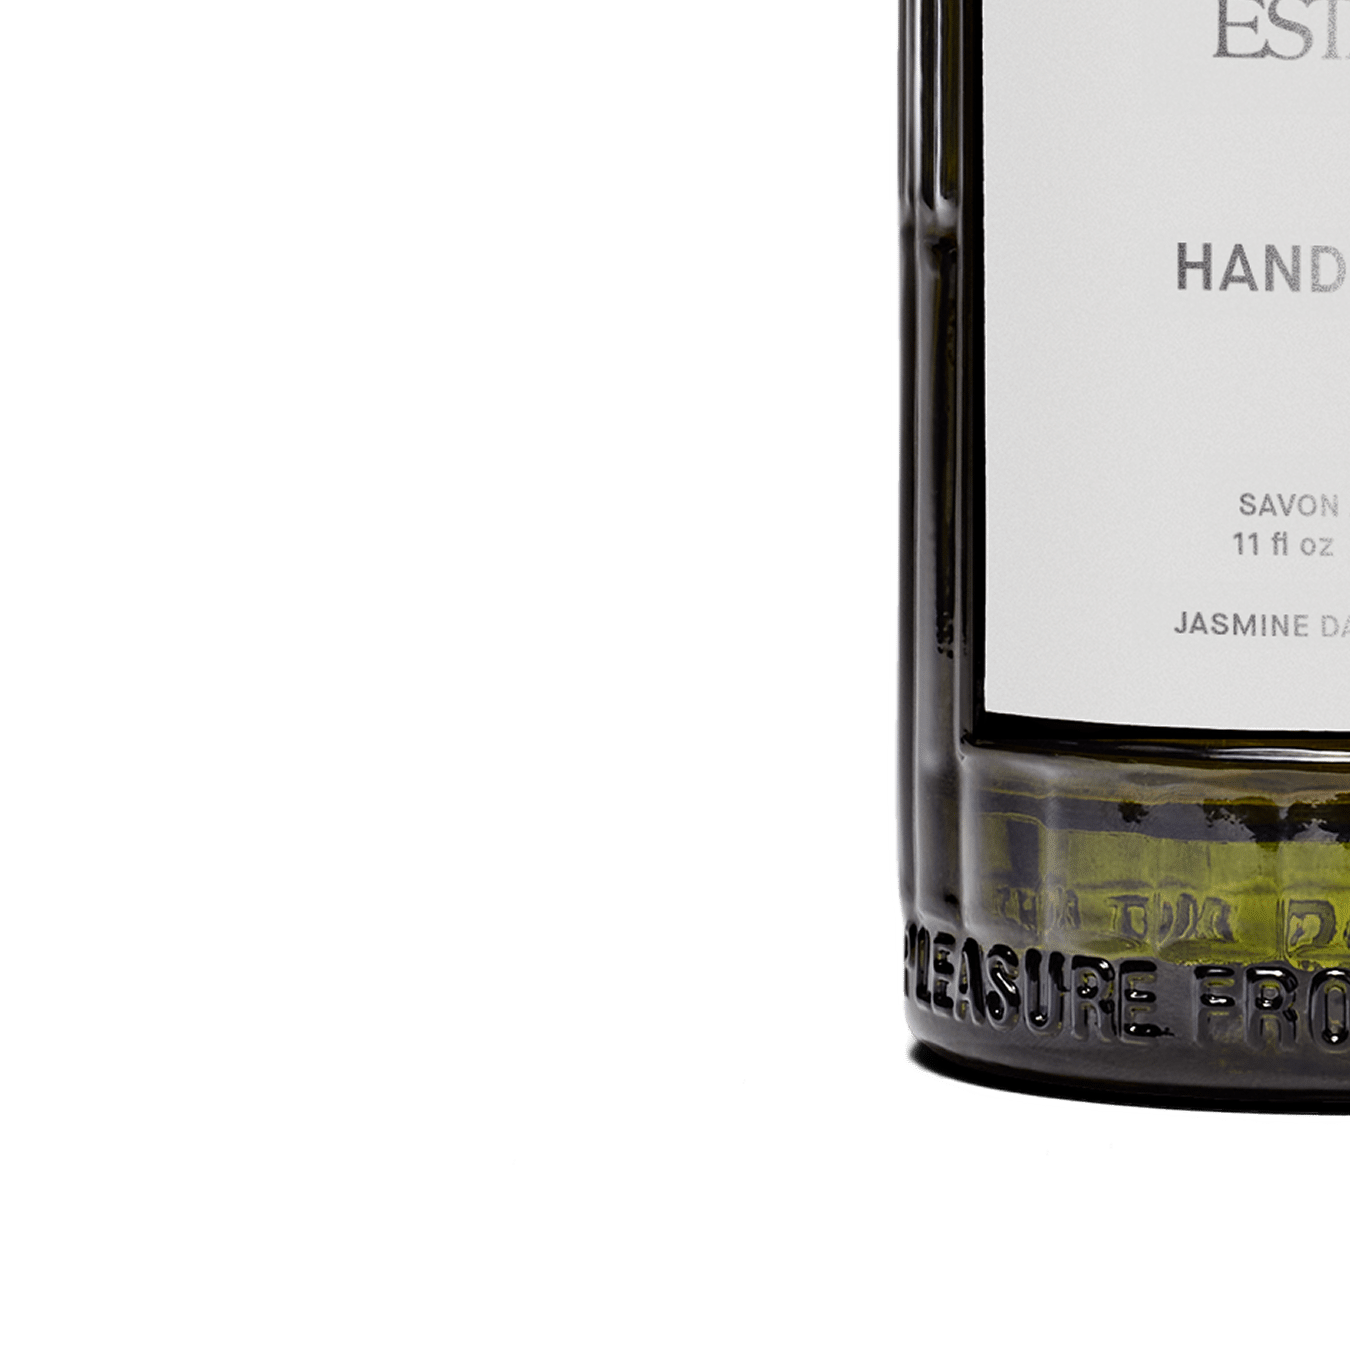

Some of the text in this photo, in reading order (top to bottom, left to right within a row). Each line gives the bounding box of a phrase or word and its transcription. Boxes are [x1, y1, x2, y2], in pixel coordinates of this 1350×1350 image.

[1177, 242, 1347, 293] HAND
[1238, 492, 1339, 517] SAVON
[1233, 532, 1259, 556] 11
[1271, 531, 1288, 556] fl
[1300, 536, 1334, 556] oz
[1174, 611, 1309, 638] JASMINE
